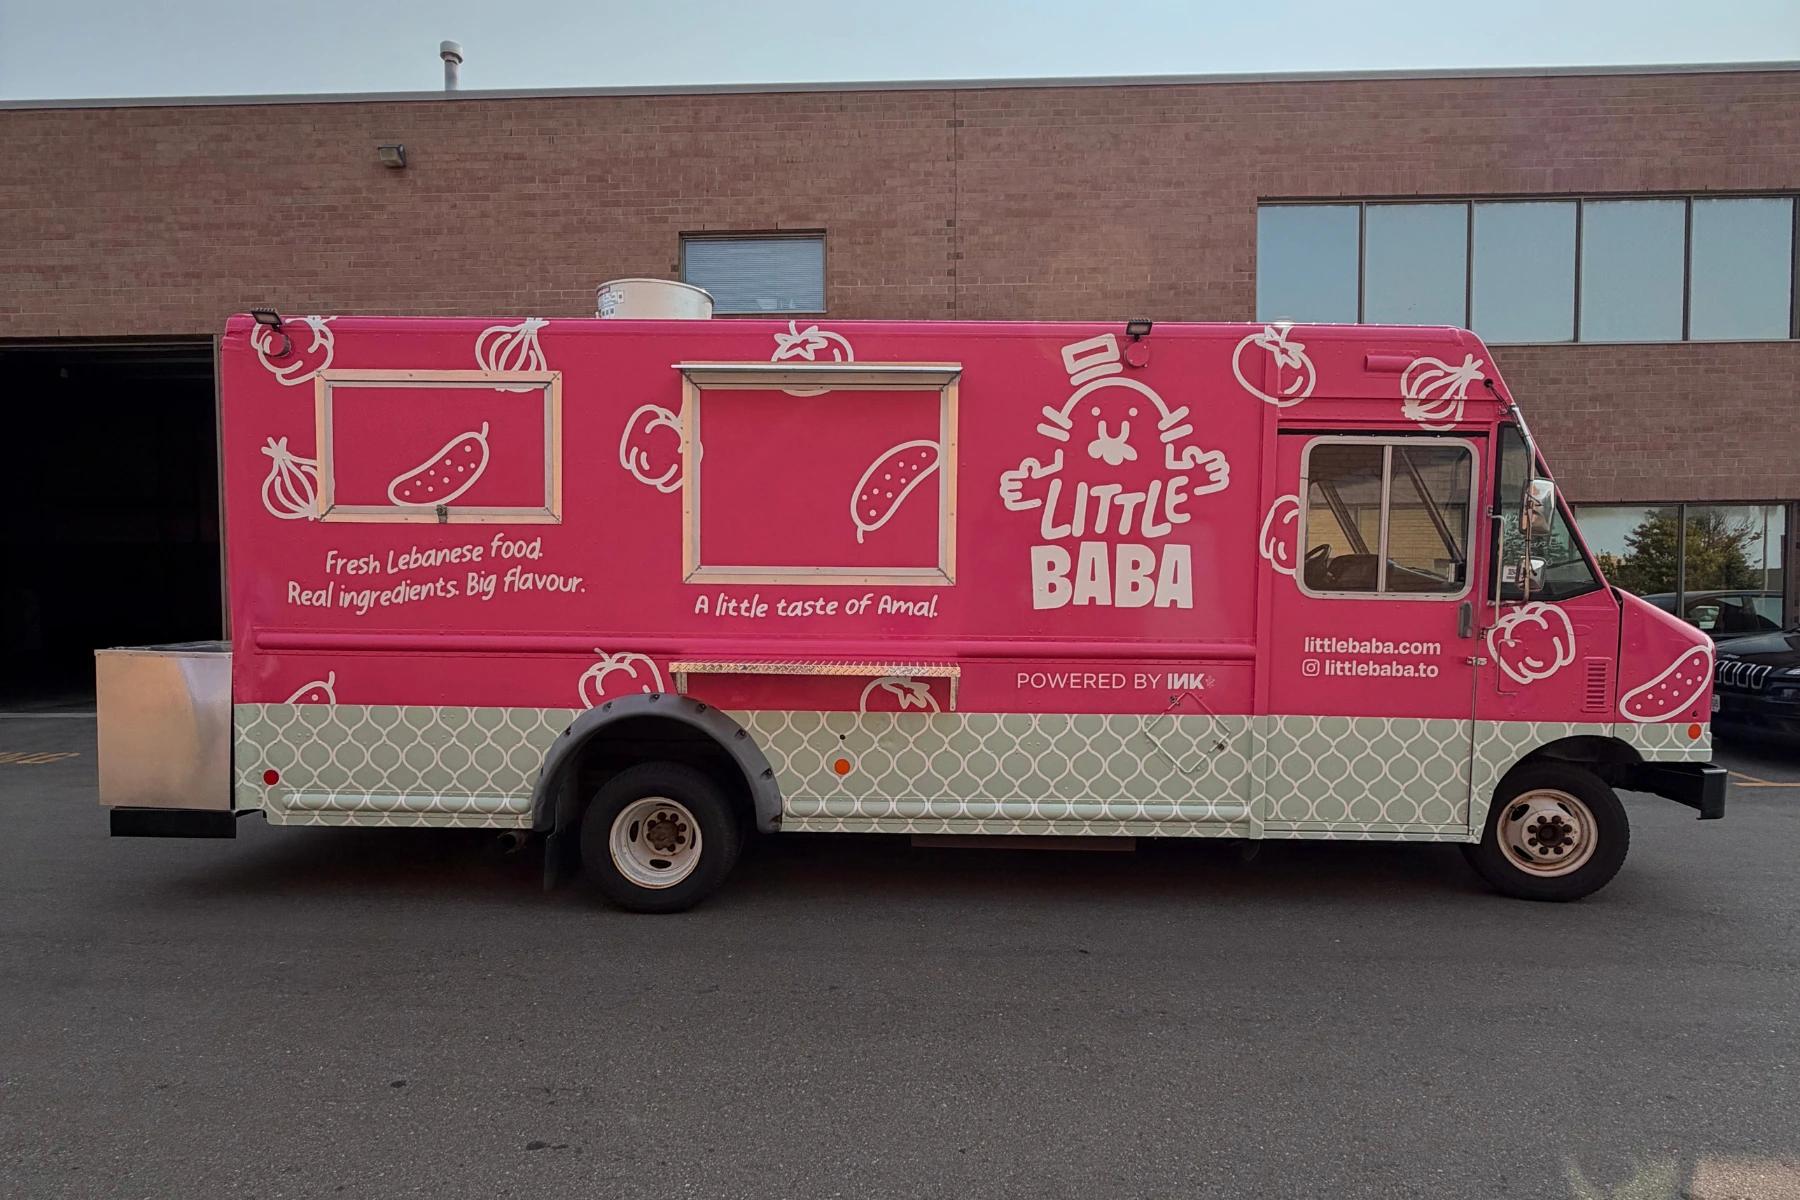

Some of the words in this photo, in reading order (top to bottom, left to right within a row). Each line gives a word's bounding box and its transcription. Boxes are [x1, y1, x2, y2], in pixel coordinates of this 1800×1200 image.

[1041, 475, 1192, 541] LITTLE
[325, 550, 381, 575] Fresh
[386, 543, 484, 575] Lebanese
[490, 532, 543, 560] food.
[287, 580, 335, 608] Real
[338, 576, 461, 616] ingredients.
[466, 570, 497, 601] Big
[503, 565, 587, 594] flavour.
[1030, 540, 1194, 610] BABA
[694, 595, 709, 614] A
[715, 592, 769, 618] little
[776, 597, 839, 617] taste
[844, 592, 875, 615] of
[877, 594, 939, 619] Amal.
[1304, 636, 1441, 655] littlebaba.com
[1017, 672, 1126, 689] POWERED
[1134, 673, 1162, 689] BY
[1324, 659, 1439, 678] littlebaba.to
